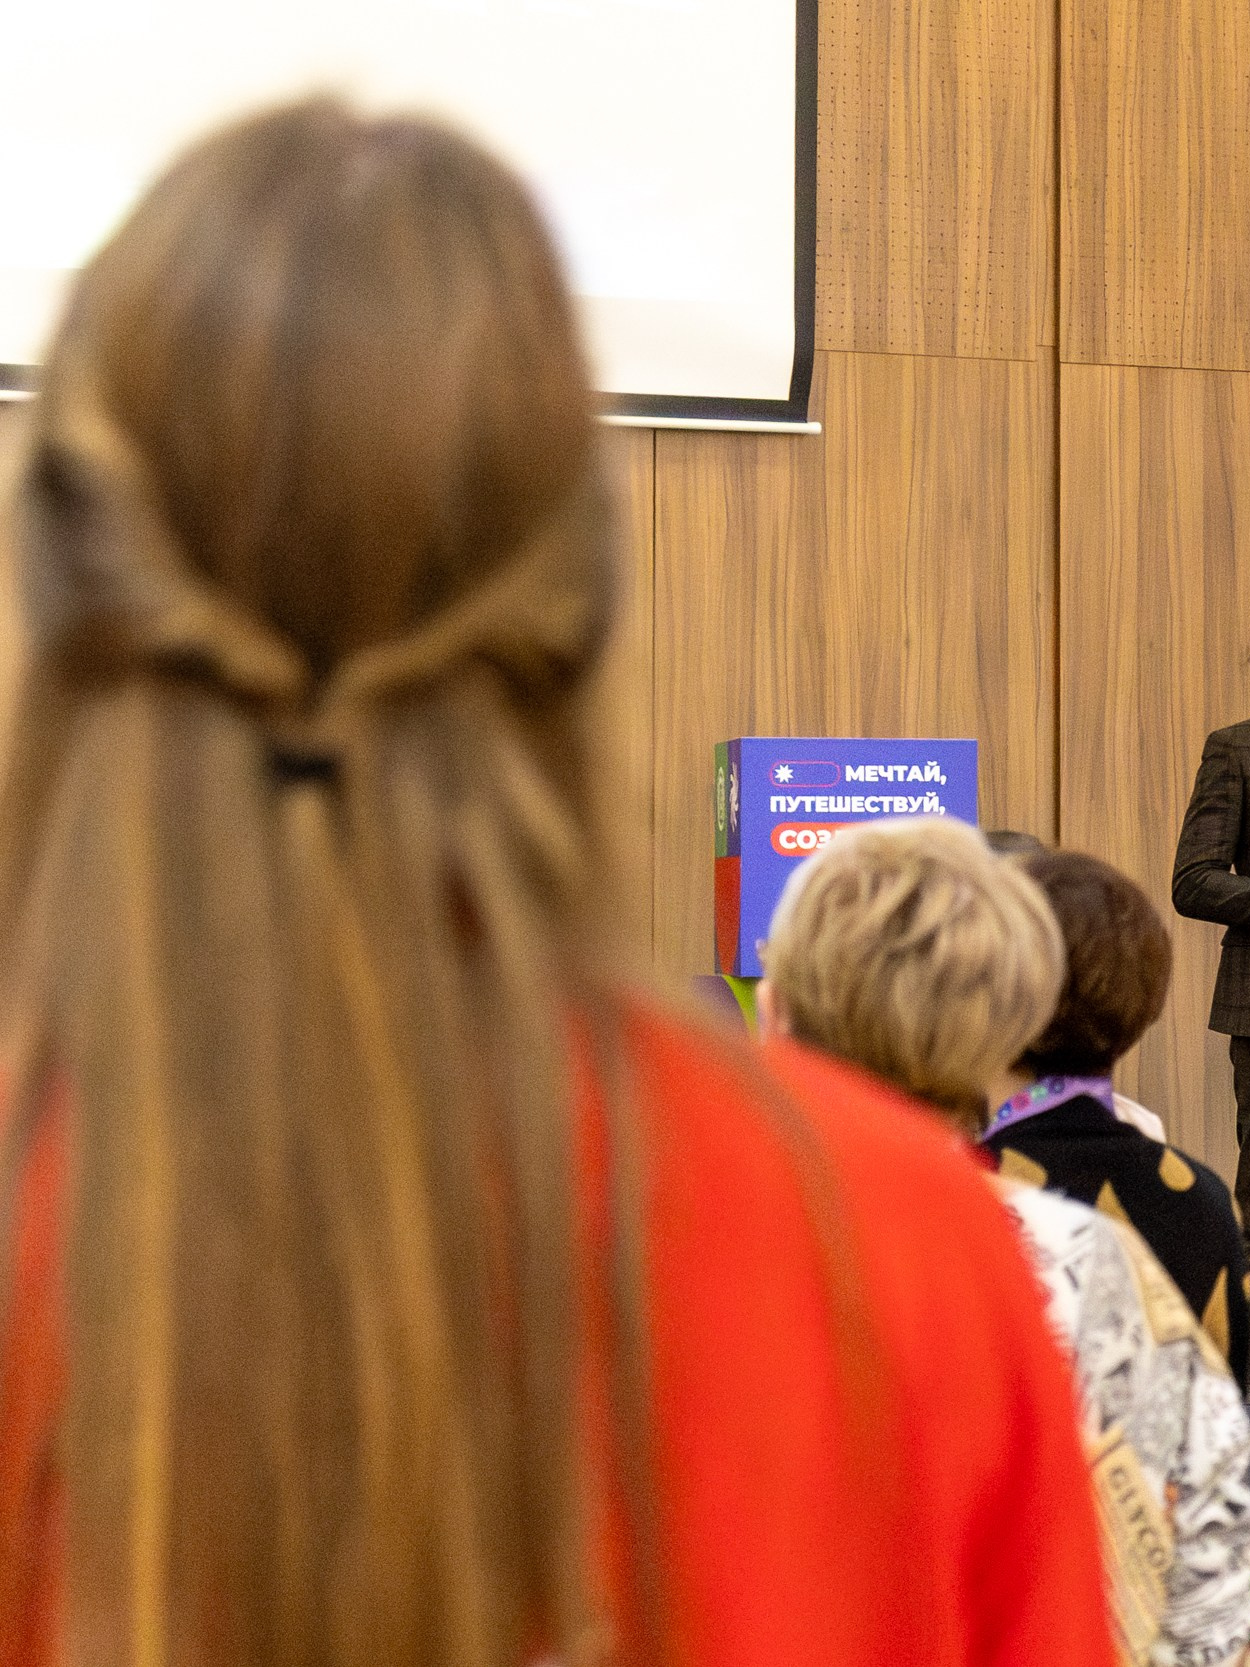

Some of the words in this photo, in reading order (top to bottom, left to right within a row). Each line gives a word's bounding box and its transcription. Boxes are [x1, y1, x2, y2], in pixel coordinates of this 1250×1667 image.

[845, 761, 947, 785] МЕЧТАЙ,
[769, 791, 946, 815] ПУТЕШЕСТВУЙ,
[778, 829, 833, 850] СОЗ
